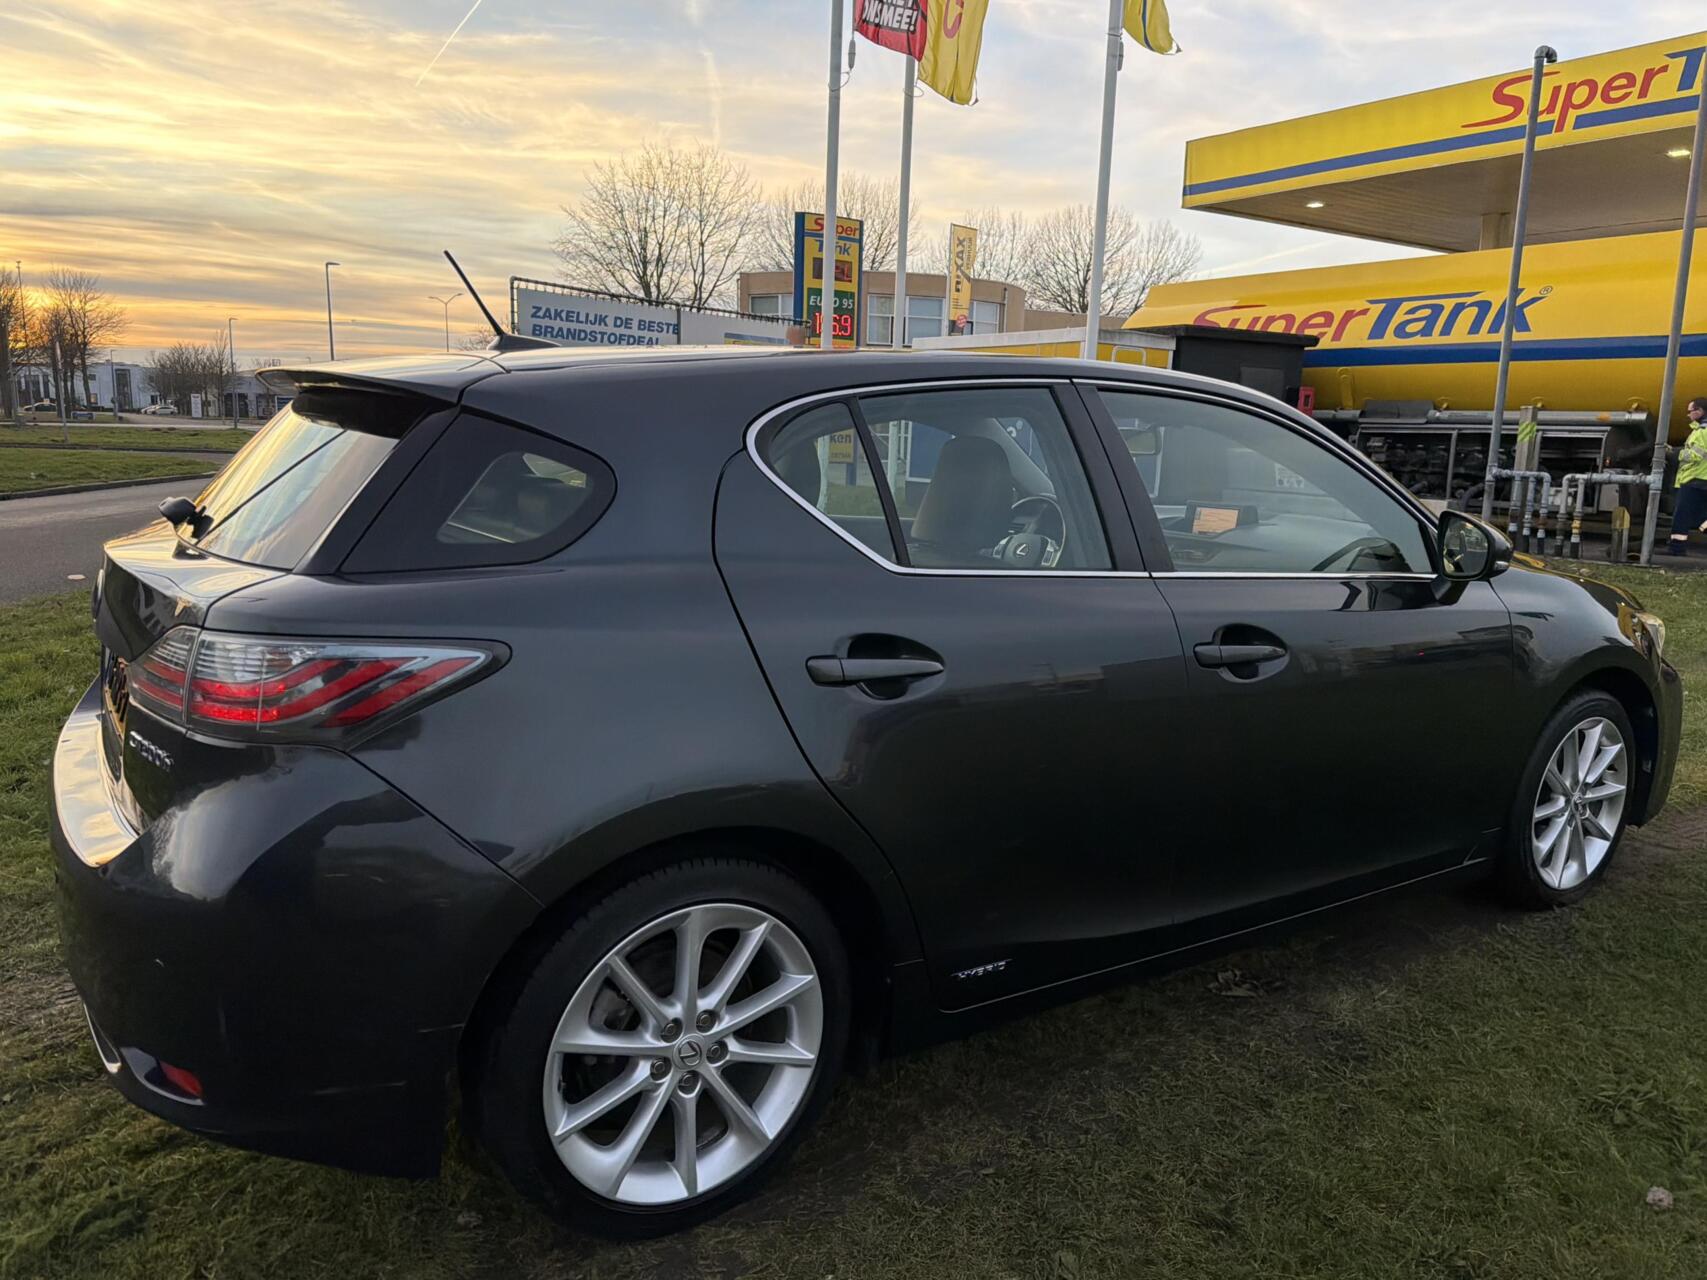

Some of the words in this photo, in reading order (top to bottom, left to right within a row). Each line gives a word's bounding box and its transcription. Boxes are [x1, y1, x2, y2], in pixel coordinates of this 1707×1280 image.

[805, 217, 858, 237] Sper
[813, 239, 852, 256] Tnk
[809, 295, 839, 308] EUO
[842, 299, 854, 309] 95
[530, 306, 609, 327] ZAKELIJK
[613, 316, 634, 330] DE
[637, 319, 680, 336] BESTE
